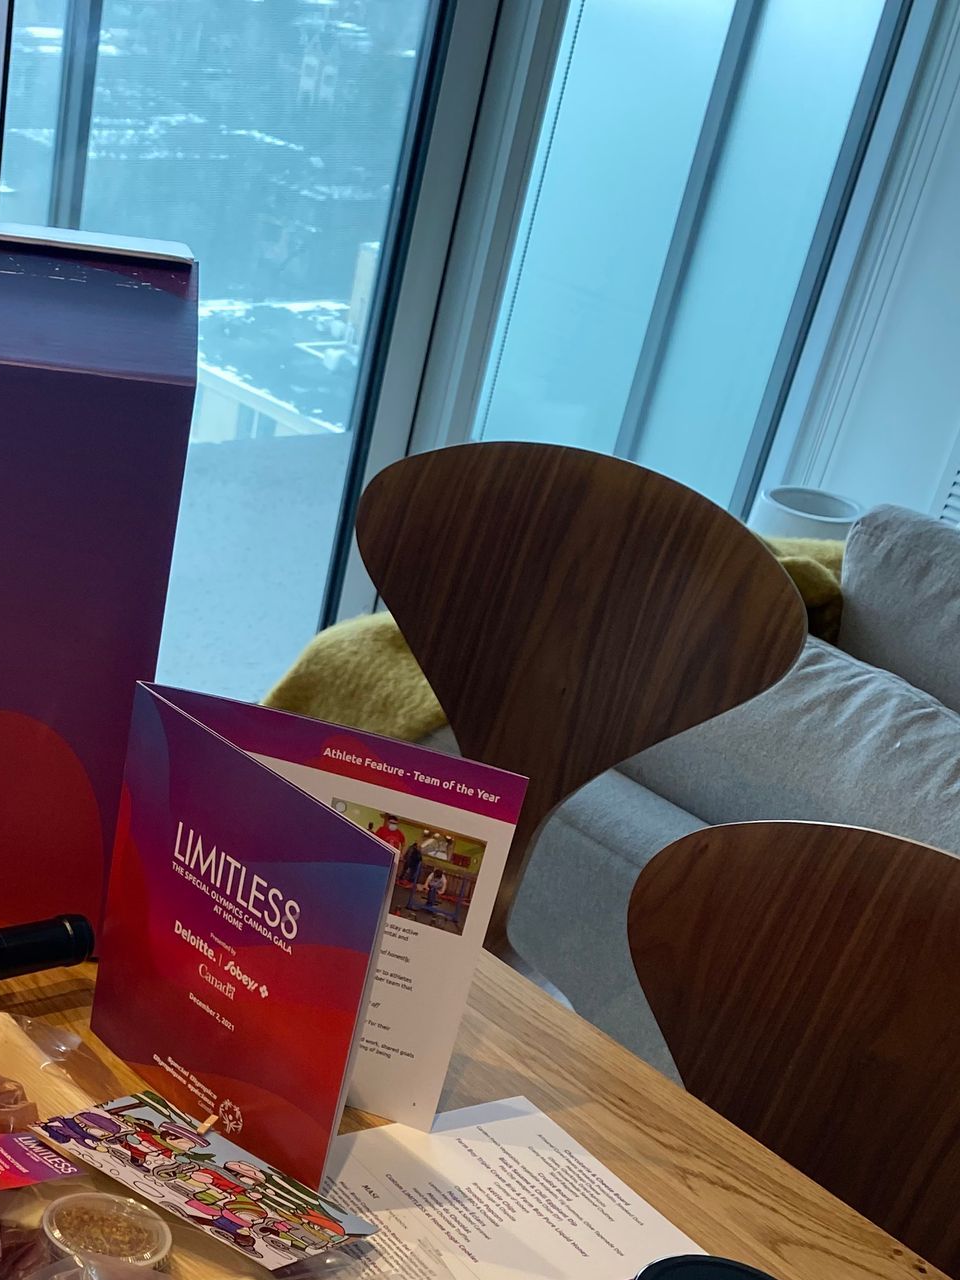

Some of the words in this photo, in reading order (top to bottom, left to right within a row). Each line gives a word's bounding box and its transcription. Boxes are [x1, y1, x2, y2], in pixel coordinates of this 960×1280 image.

[323, 747, 362, 765] Athlete
[364, 758, 404, 776] Feature
[413, 771, 440, 786] Team
[443, 780, 455, 790] of
[456, 783, 474, 796] the
[477, 789, 500, 803] Year
[172, 861, 184, 876] THE
[185, 871, 210, 895] SPECIAL
[211, 890, 243, 918] OLYMPICS
[244, 914, 272, 940] CANADA
[273, 936, 291, 955] GALA
[213, 904, 222, 915] AT
[223, 911, 243, 930] HOME
[175, 920, 216, 961] Deloitte.
[199, 964, 235, 1000] Canada
[189, 992, 215, 1016] December
[221, 1017, 234, 1031] 2021
